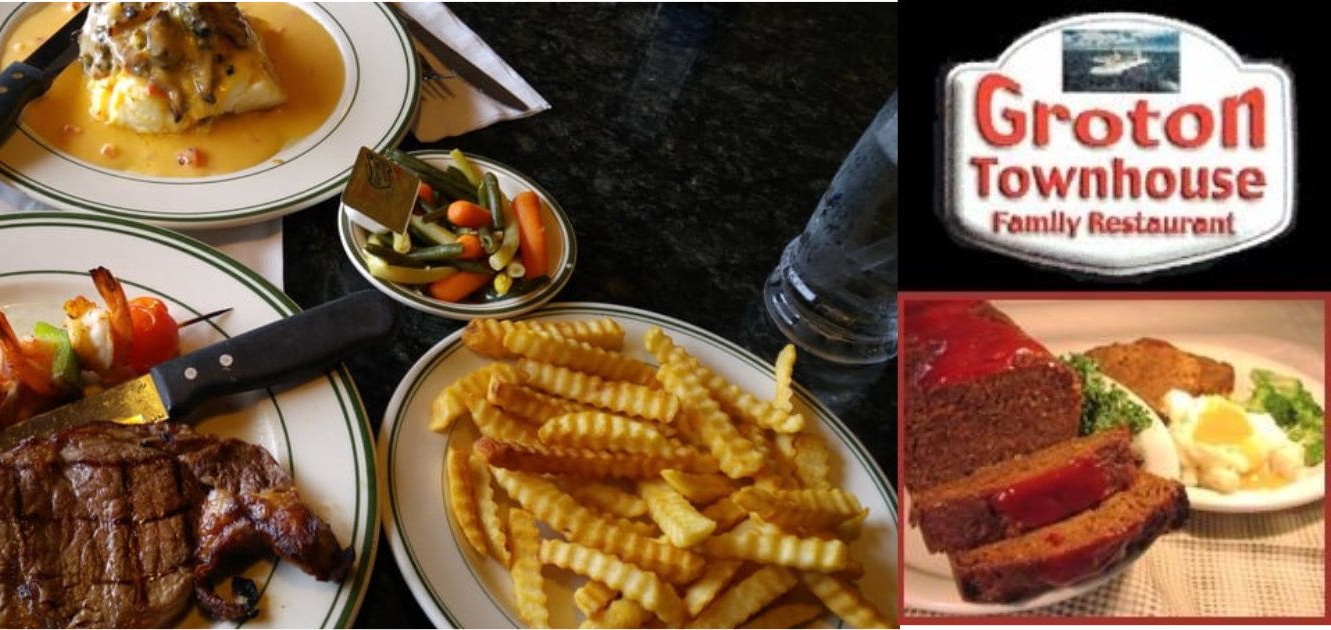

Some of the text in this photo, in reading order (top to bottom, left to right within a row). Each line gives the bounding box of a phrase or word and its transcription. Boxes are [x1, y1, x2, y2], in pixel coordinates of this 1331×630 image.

[975, 73, 1265, 149] Groton
[971, 158, 1266, 200] Townhouse
[991, 211, 1236, 238] Family Restaurant
